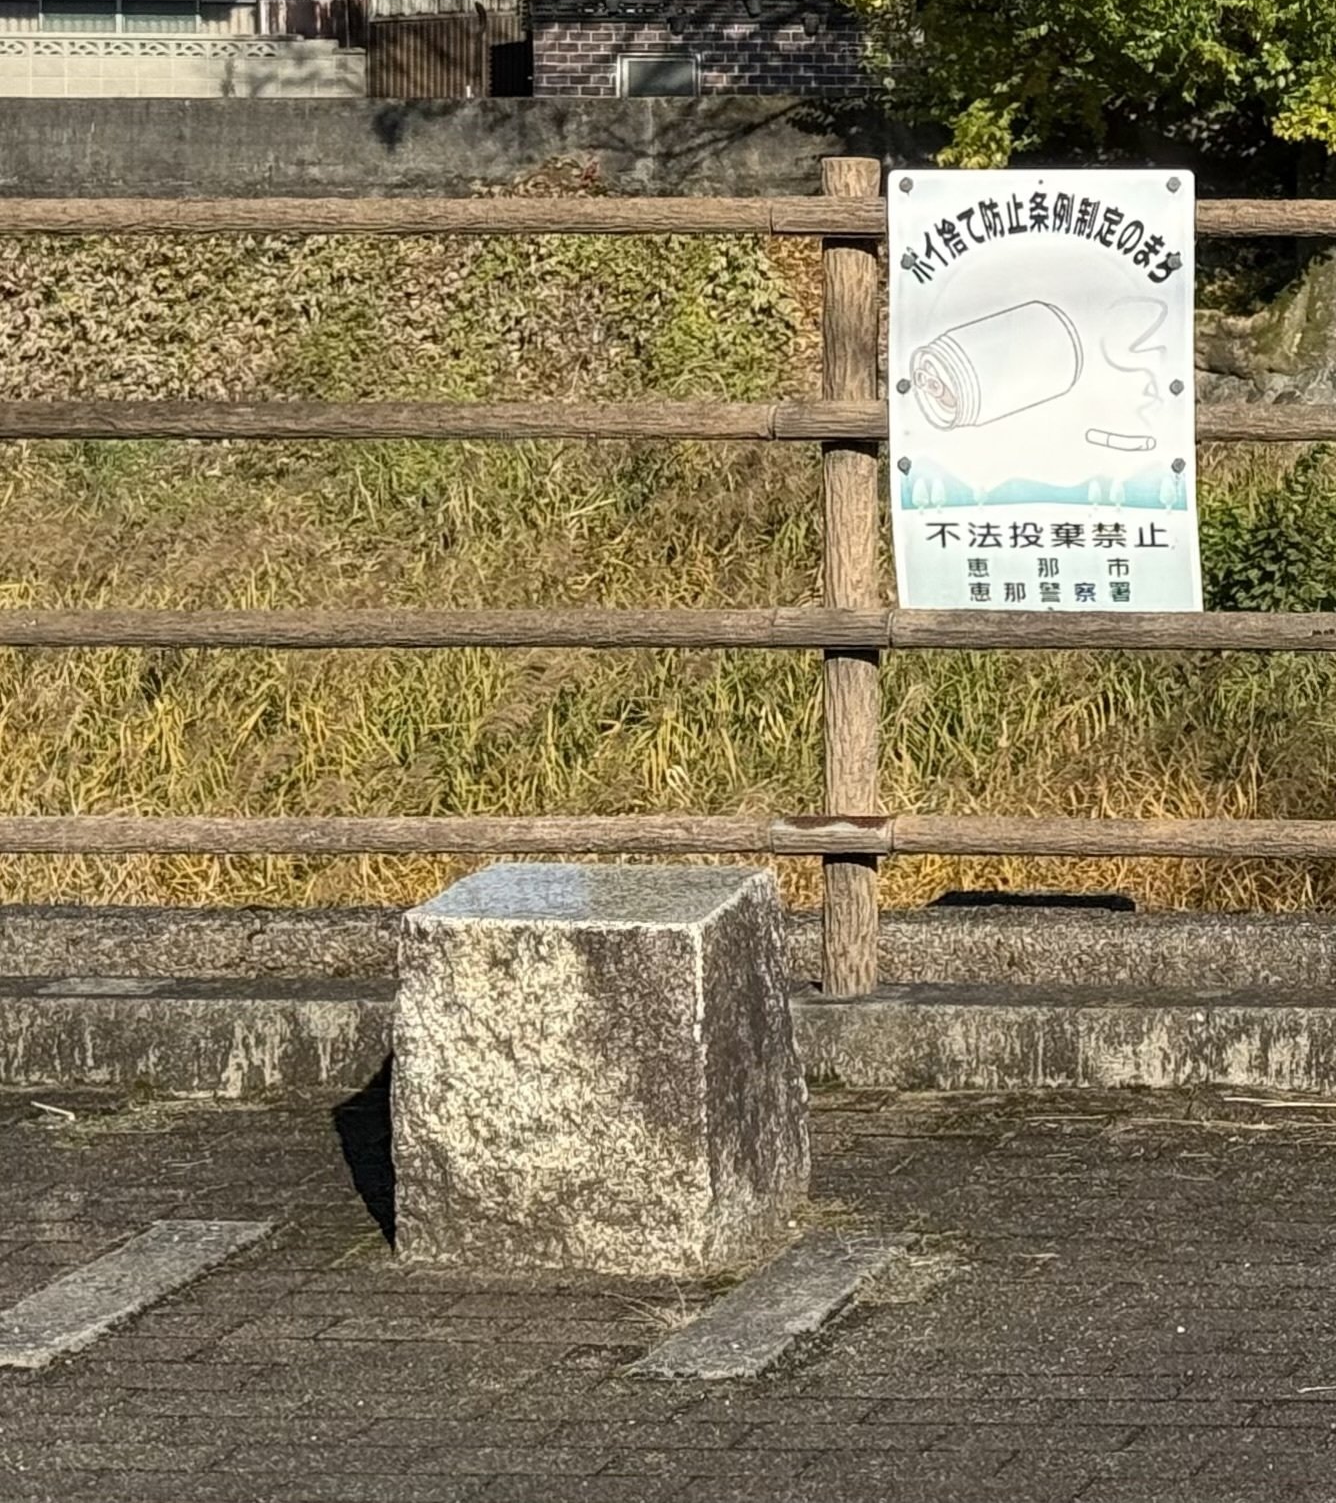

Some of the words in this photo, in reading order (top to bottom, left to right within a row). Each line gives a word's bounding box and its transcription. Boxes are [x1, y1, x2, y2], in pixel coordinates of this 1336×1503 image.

[925, 522, 1169, 548] 不法投棄禁止
[967, 558, 1129, 578] 恵那市
[969, 581, 1131, 602] 恵那警察署
